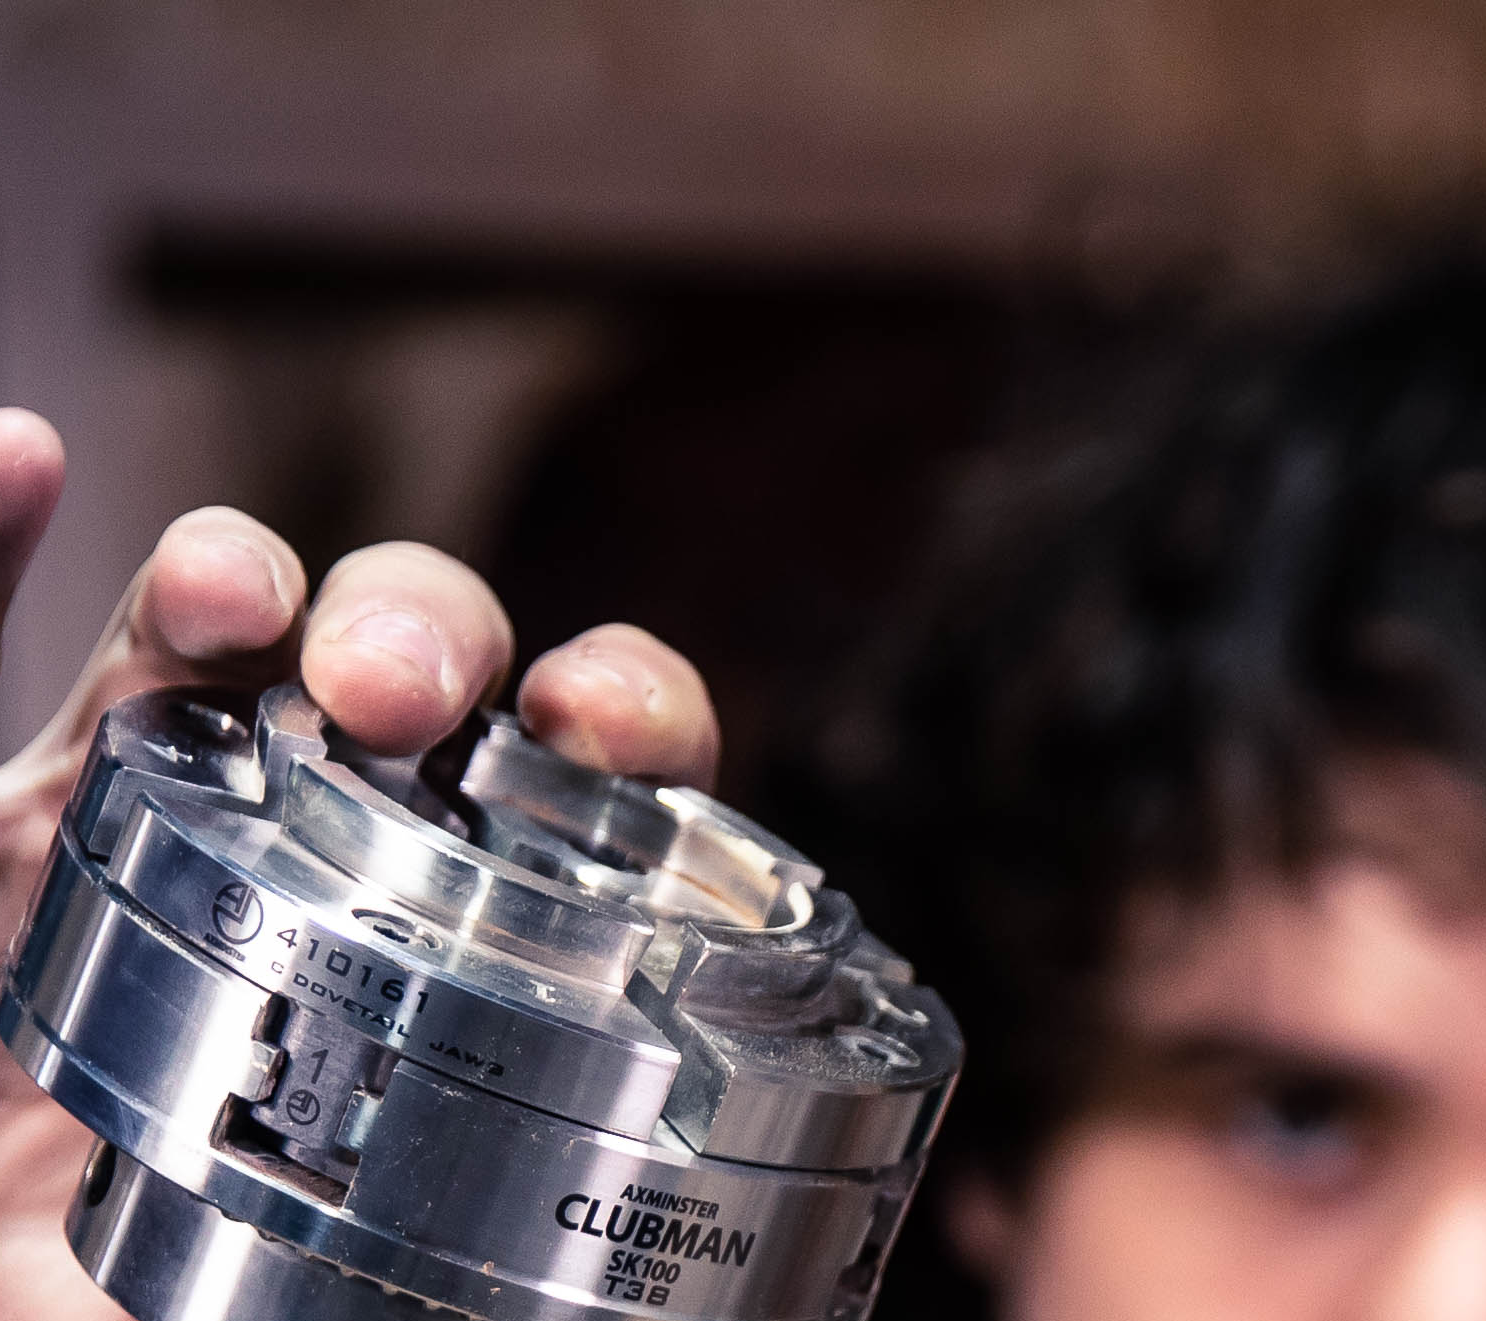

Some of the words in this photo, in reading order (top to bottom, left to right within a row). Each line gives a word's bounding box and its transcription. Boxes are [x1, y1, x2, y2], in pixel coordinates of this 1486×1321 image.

[276, 928, 429, 1014] 410161
[271, 961, 284, 974] C
[293, 972, 410, 1038] DOVETAIL
[620, 1184, 719, 1220] AXMINSTER
[555, 1193, 756, 1267] CLUBMAN
[605, 1274, 670, 1306] T38
[607, 1250, 680, 1284] SK100
